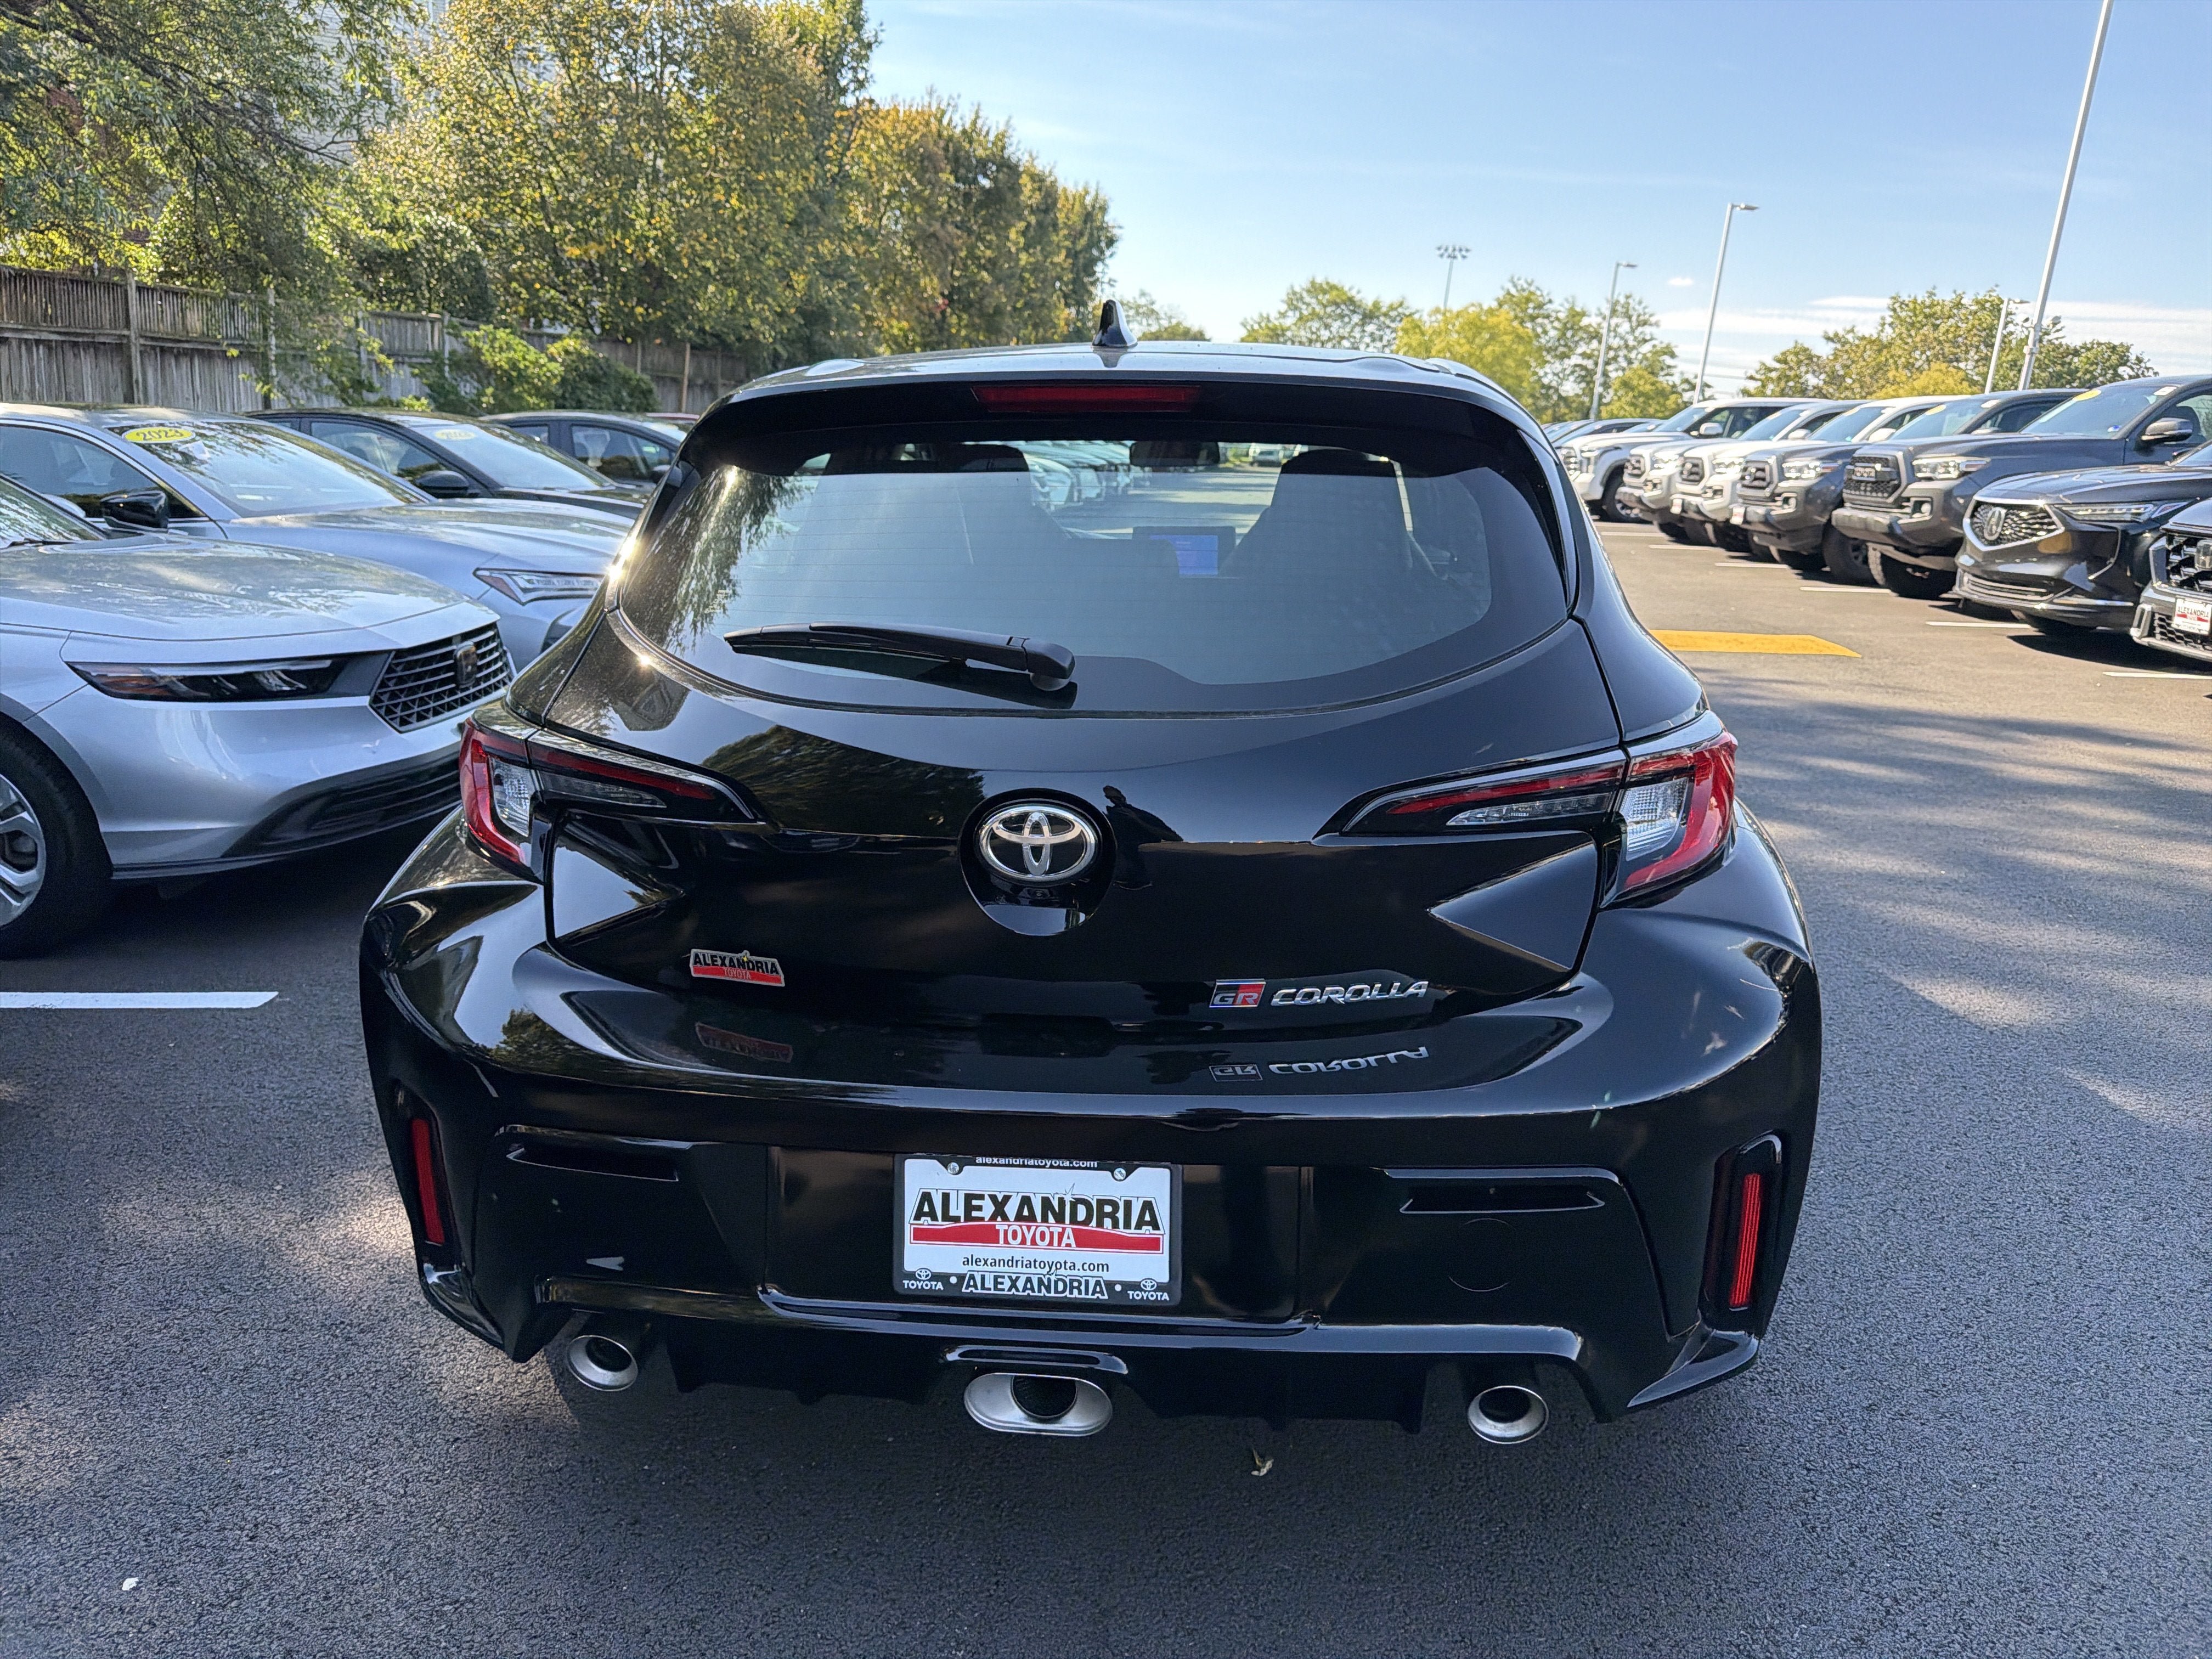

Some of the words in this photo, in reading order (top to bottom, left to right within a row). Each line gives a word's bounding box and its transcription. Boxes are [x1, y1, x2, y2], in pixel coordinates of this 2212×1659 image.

[693, 952, 780, 975] ALEXANDRIA
[724, 968, 752, 980] TOYOTA
[1212, 991, 1259, 1006] GR
[1270, 980, 1429, 1006] COROLLA
[975, 1156, 1098, 1168] alexandriatoyota.com
[911, 1189, 1162, 1232] ALEXANDRIA
[995, 1224, 1076, 1248] TOYOTA
[962, 1255, 1109, 1273] alexandriatoyota.com
[902, 1280, 944, 1290] TOYOTA
[963, 1272, 1107, 1299] ALEXANDRIA
[1127, 1290, 1170, 1301] TOYOTA
